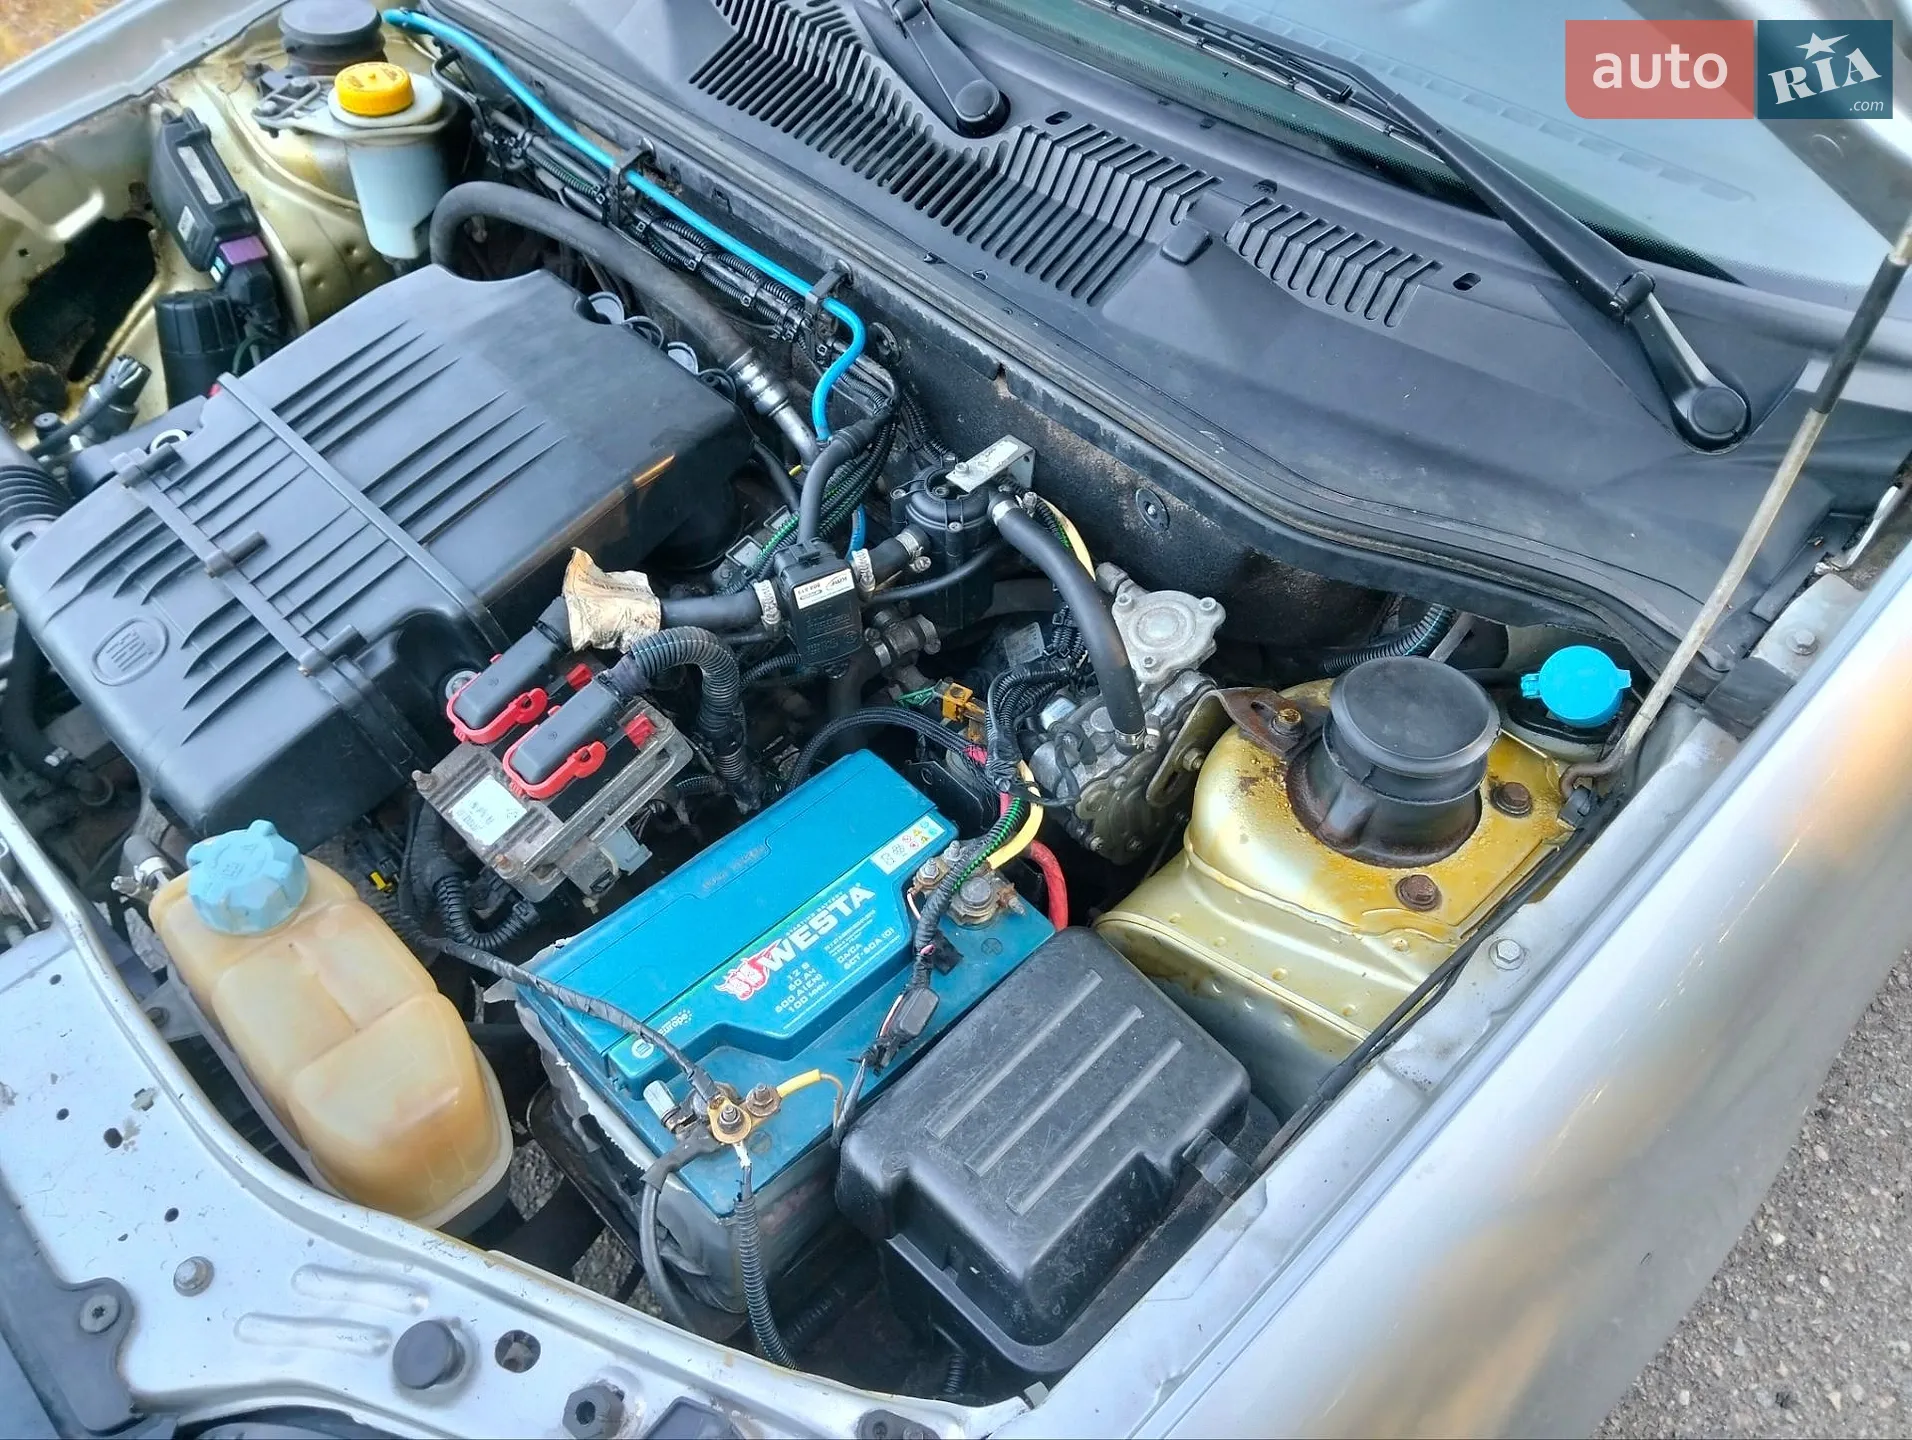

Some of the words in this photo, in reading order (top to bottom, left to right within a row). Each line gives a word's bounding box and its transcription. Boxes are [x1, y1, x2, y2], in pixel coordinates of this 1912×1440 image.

[757, 884, 876, 971] WESTA
[787, 968, 802, 980] 12
[788, 978, 803, 992] 60
[788, 995, 809, 1013] 100
